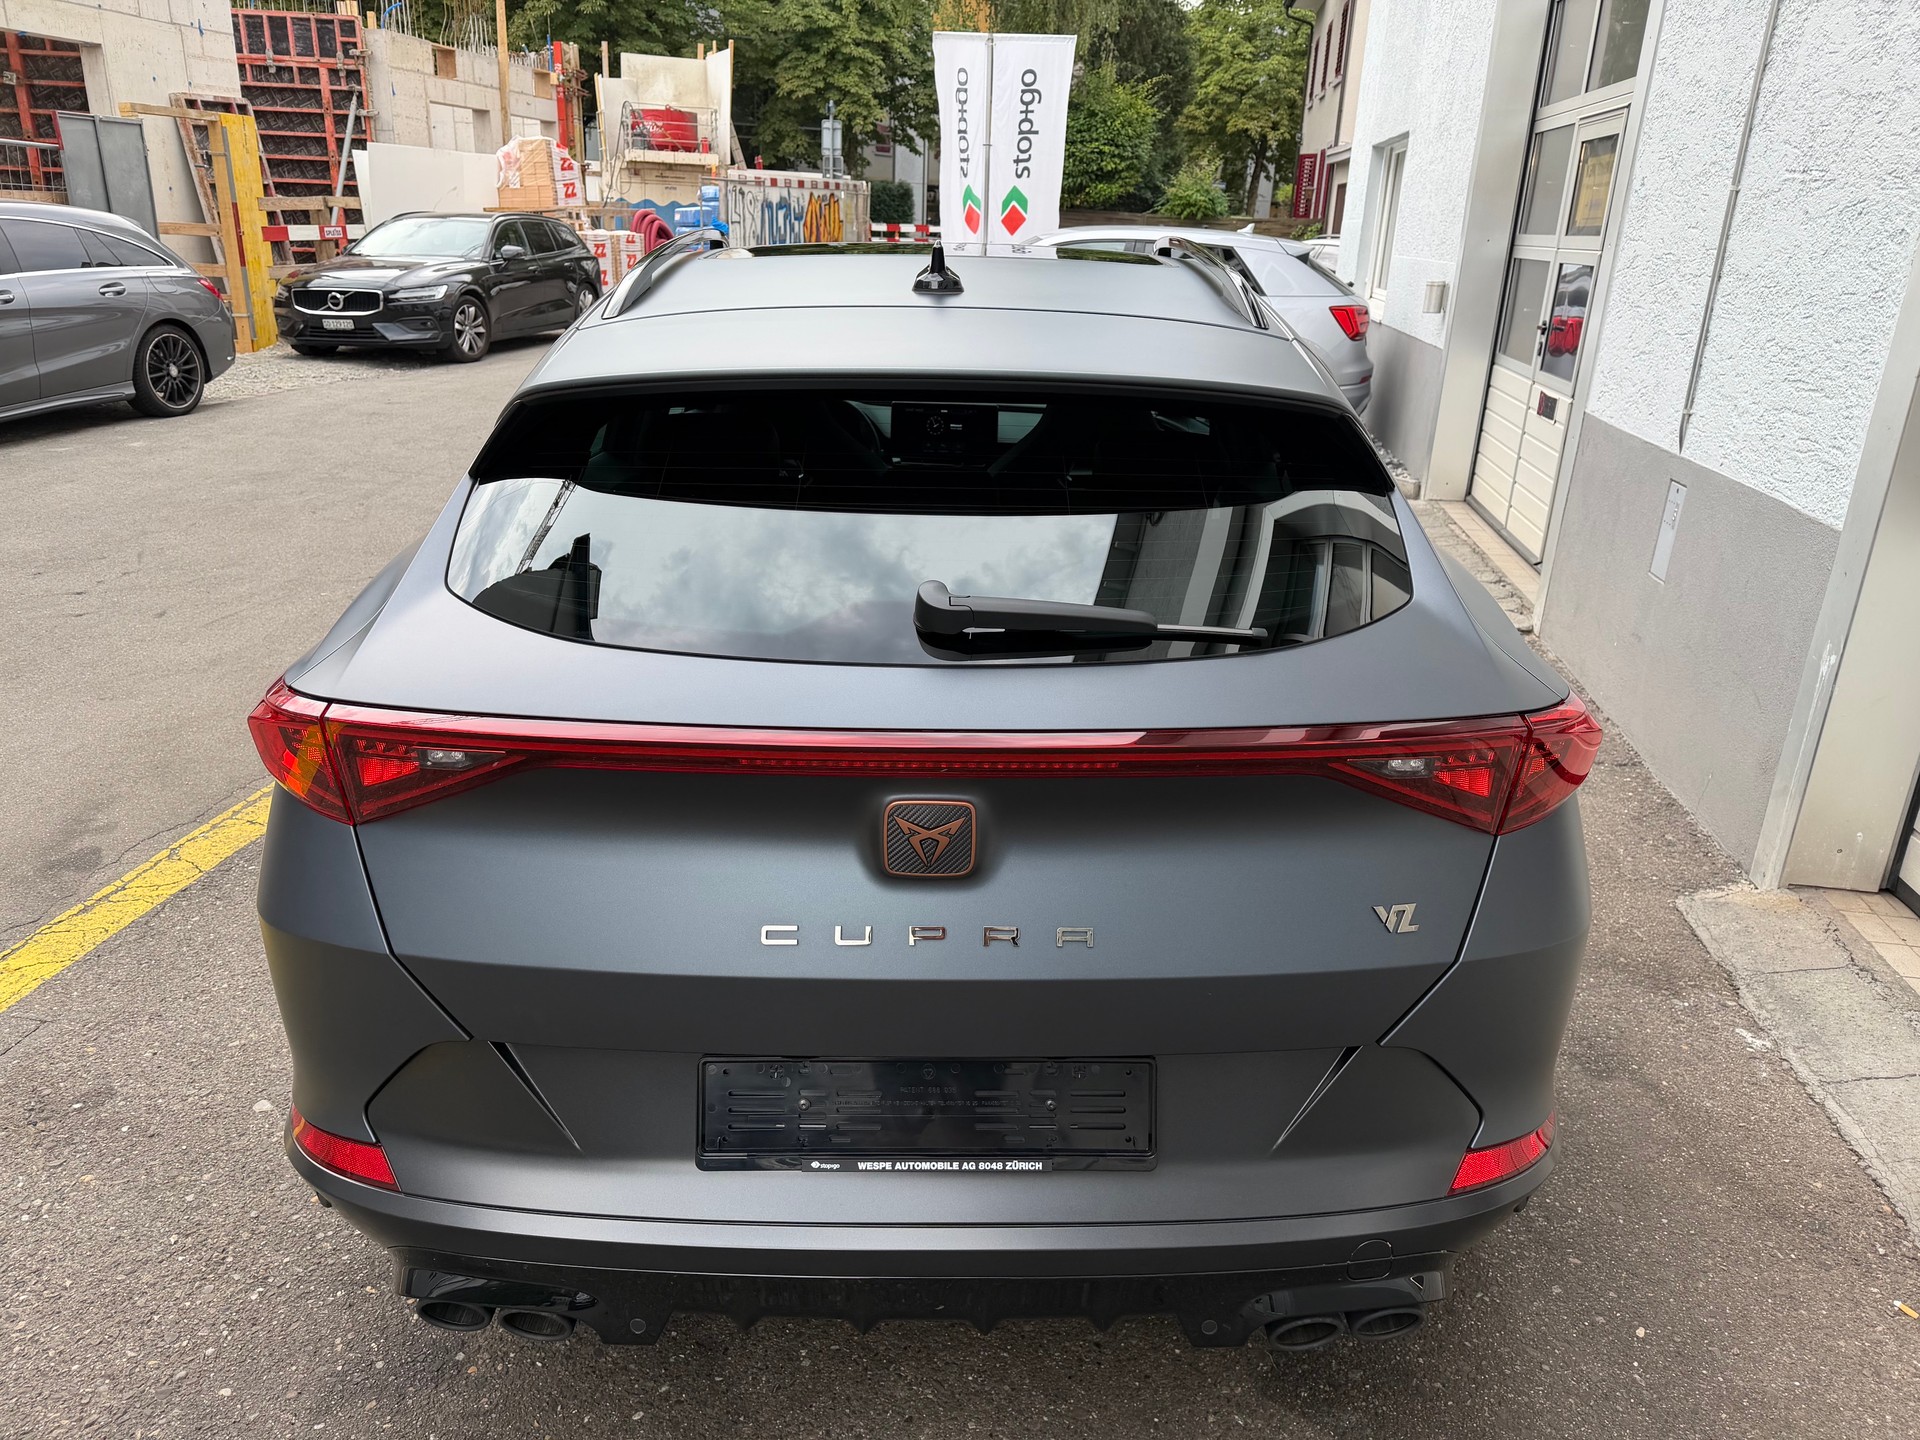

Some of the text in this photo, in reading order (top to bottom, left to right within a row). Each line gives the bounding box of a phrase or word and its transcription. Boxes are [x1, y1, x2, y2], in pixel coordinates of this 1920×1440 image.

[1013, 68, 1042, 178] stop+go
[563, 182, 577, 198] ZZ
[594, 243, 606, 258] ZZ
[760, 925, 1094, 947] CUPRA
[857, 1160, 1043, 1170] WESPE AUTOMOBILE AG 8048 ZÜRICH
